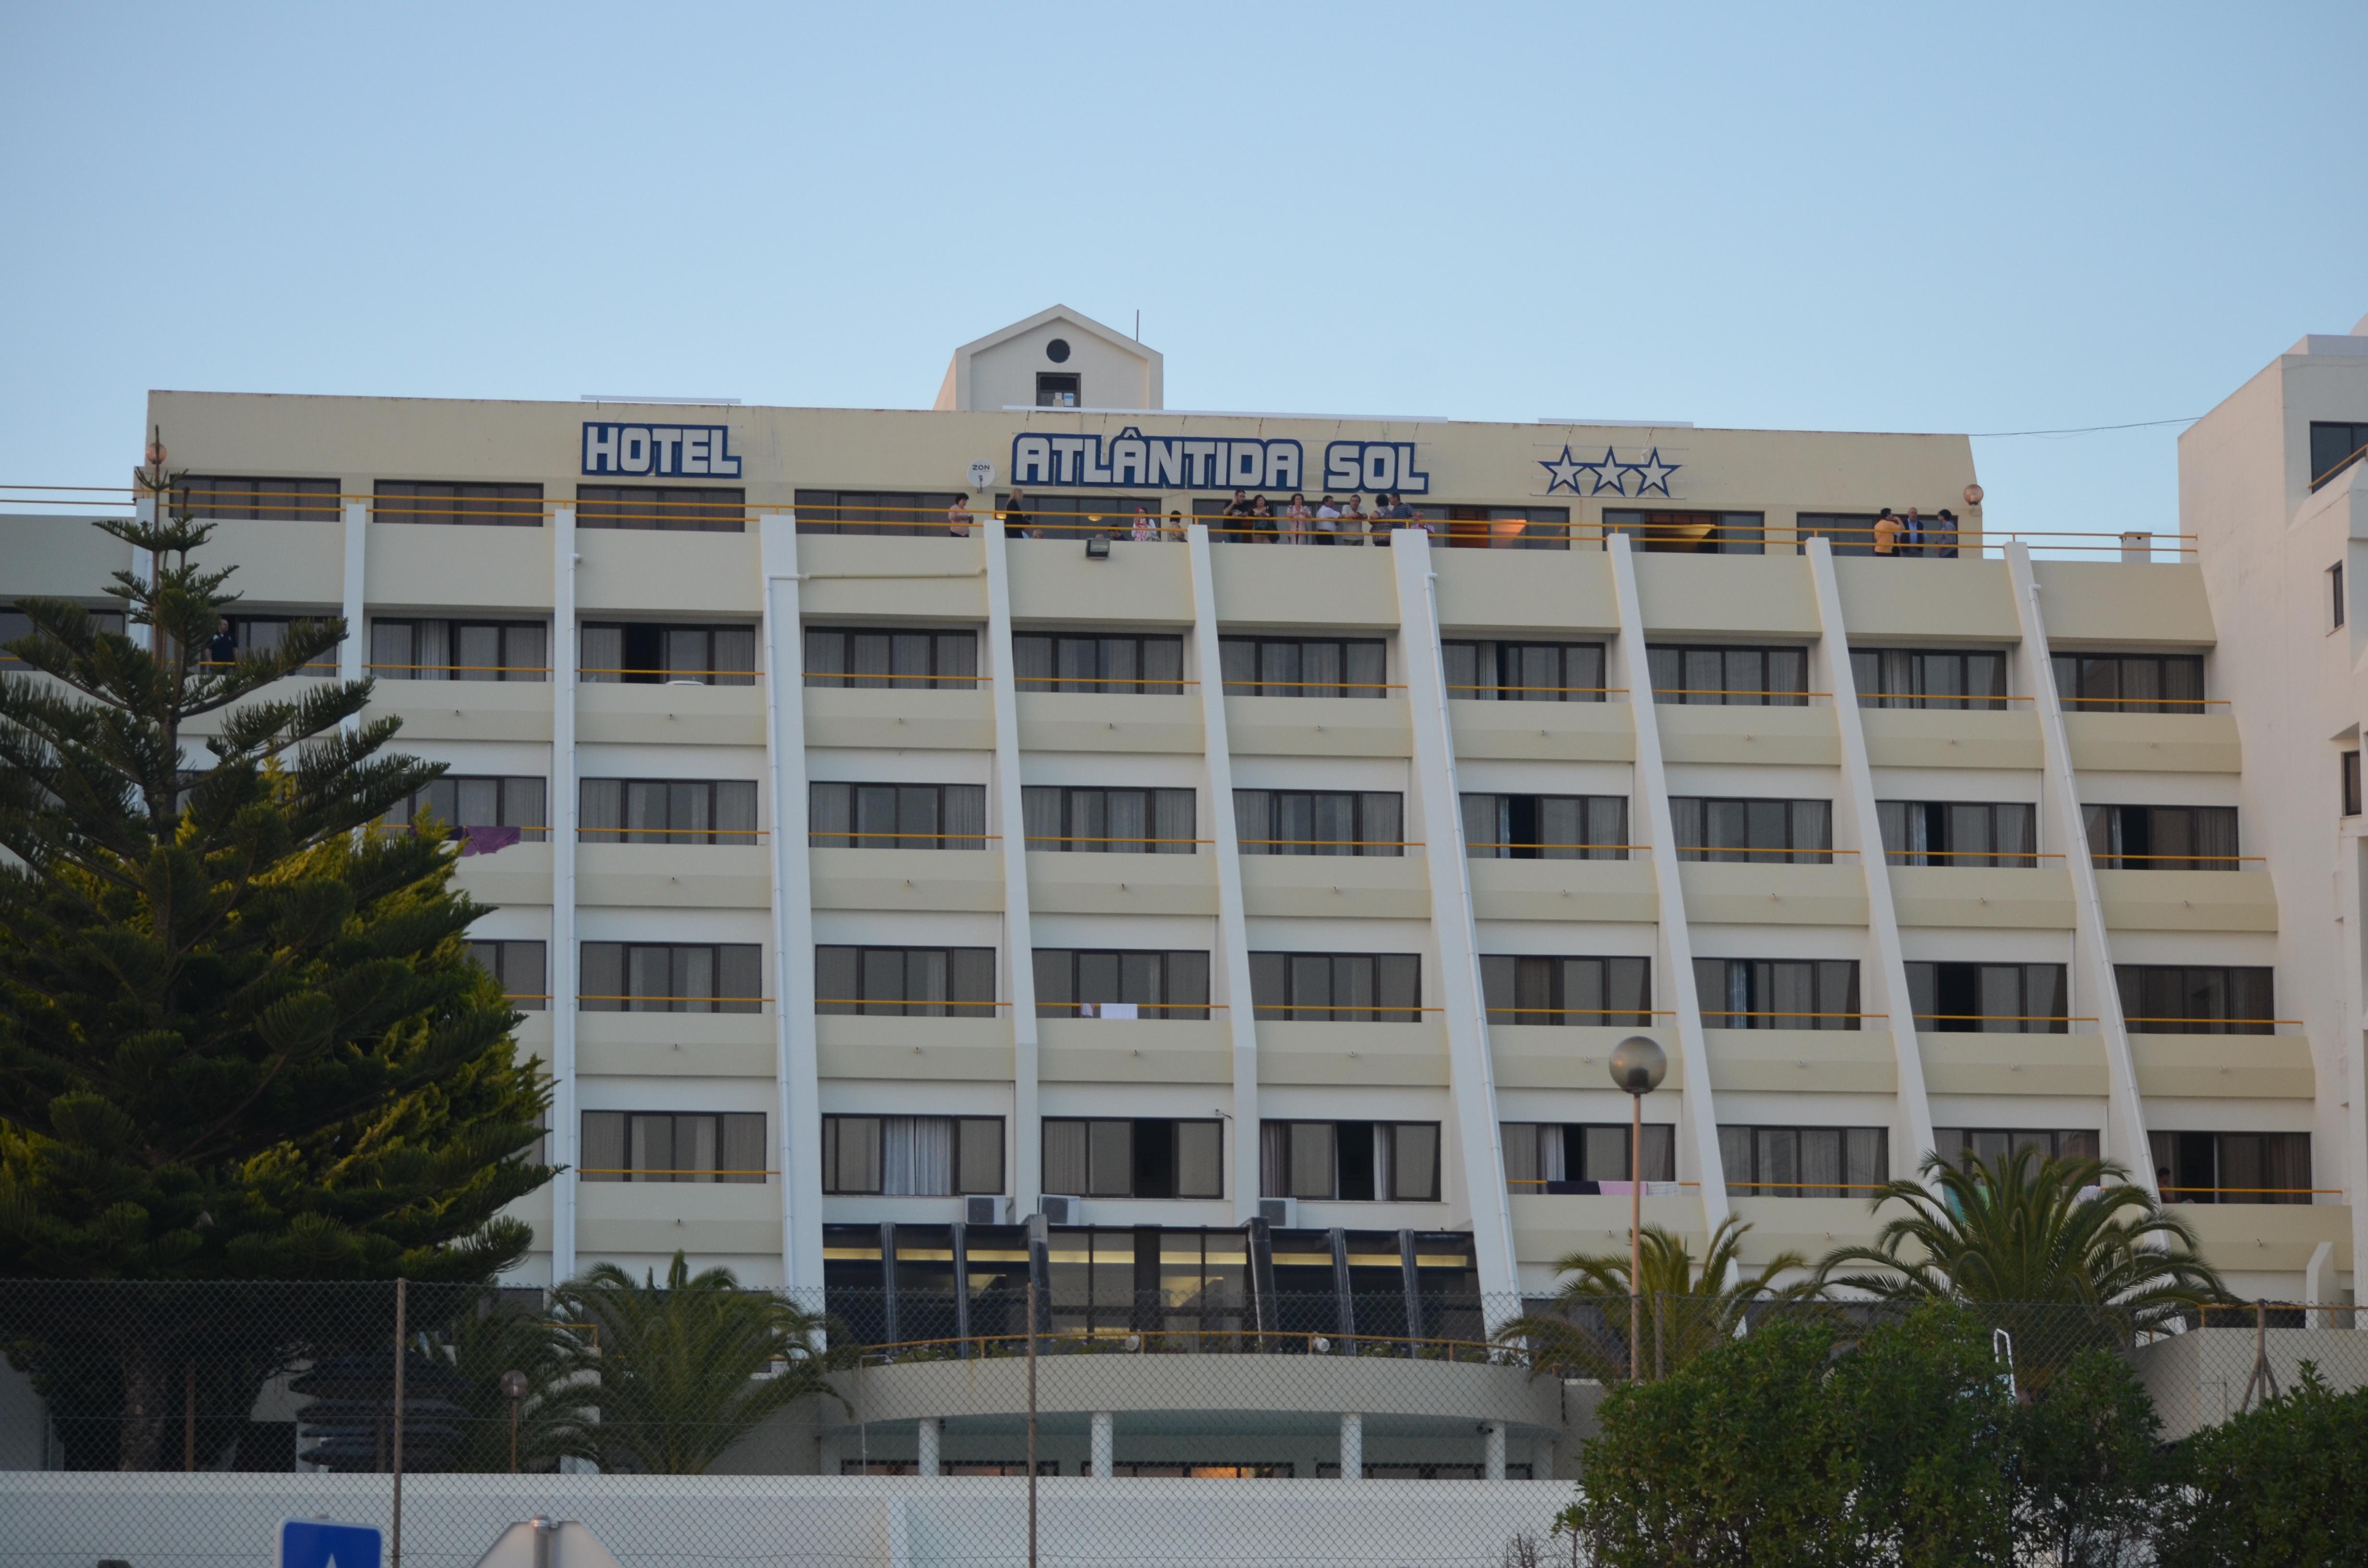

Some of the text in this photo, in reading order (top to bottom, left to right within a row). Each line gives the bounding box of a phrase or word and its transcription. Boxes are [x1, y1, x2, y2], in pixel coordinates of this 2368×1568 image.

[584, 424, 1427, 492] HOTEL ATLÂNTIDA SOL
